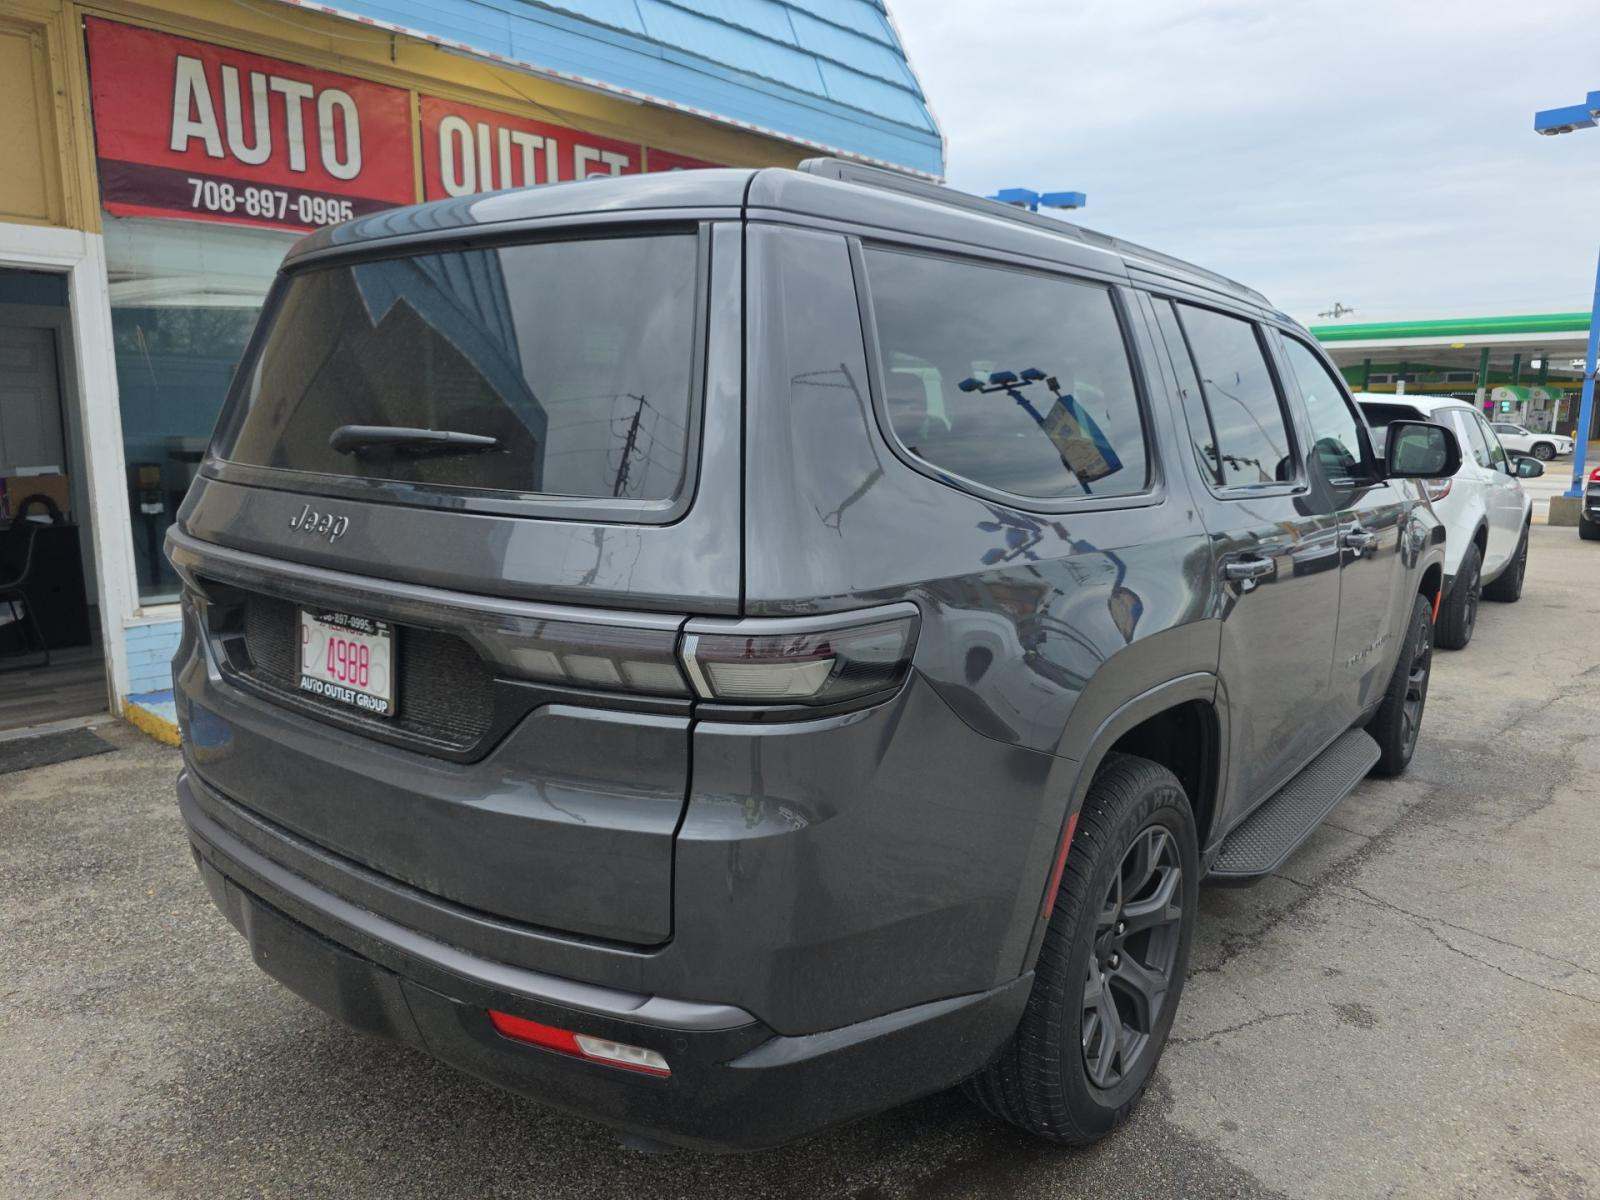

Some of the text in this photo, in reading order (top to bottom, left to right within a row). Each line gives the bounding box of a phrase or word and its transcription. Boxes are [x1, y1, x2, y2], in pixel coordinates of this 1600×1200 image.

[169, 55, 363, 181] AUTO
[187, 177, 354, 226] 708-897-0995
[290, 504, 349, 543] Jeep
[327, 637, 368, 687] 4988
[301, 676, 387, 712] AUTO OUTLET GROUP
